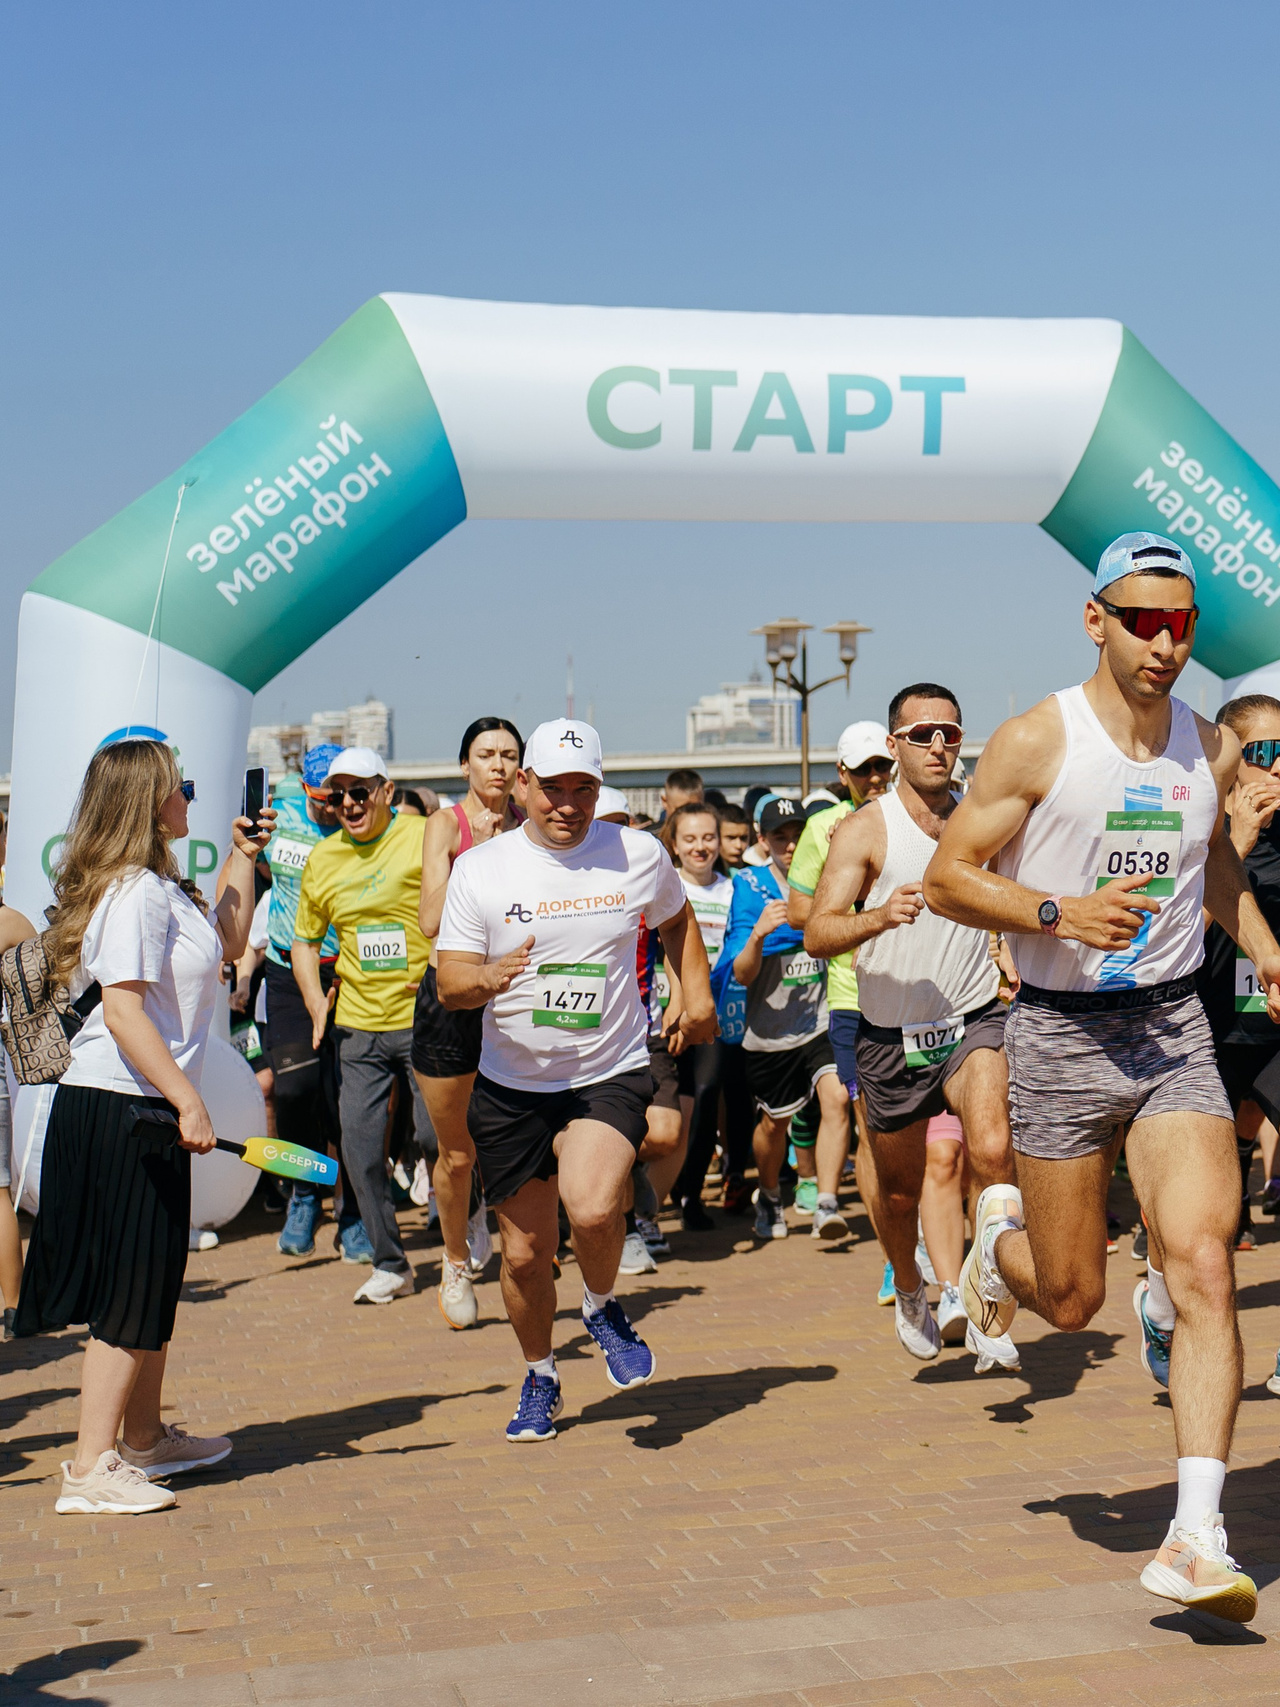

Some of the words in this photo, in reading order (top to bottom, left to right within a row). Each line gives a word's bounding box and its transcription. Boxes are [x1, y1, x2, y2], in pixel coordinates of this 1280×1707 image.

[586, 365, 967, 456] СТАРТ
[186, 413, 364, 573] зелёный
[216, 452, 392, 607] марафон
[1107, 851, 1170, 876] 0538
[536, 891, 626, 916] ДОРСТРОЙ
[363, 942, 402, 958] 0002
[786, 960, 819, 976] 0778
[543, 990, 597, 1011] 1477
[912, 1025, 958, 1049] 1077
